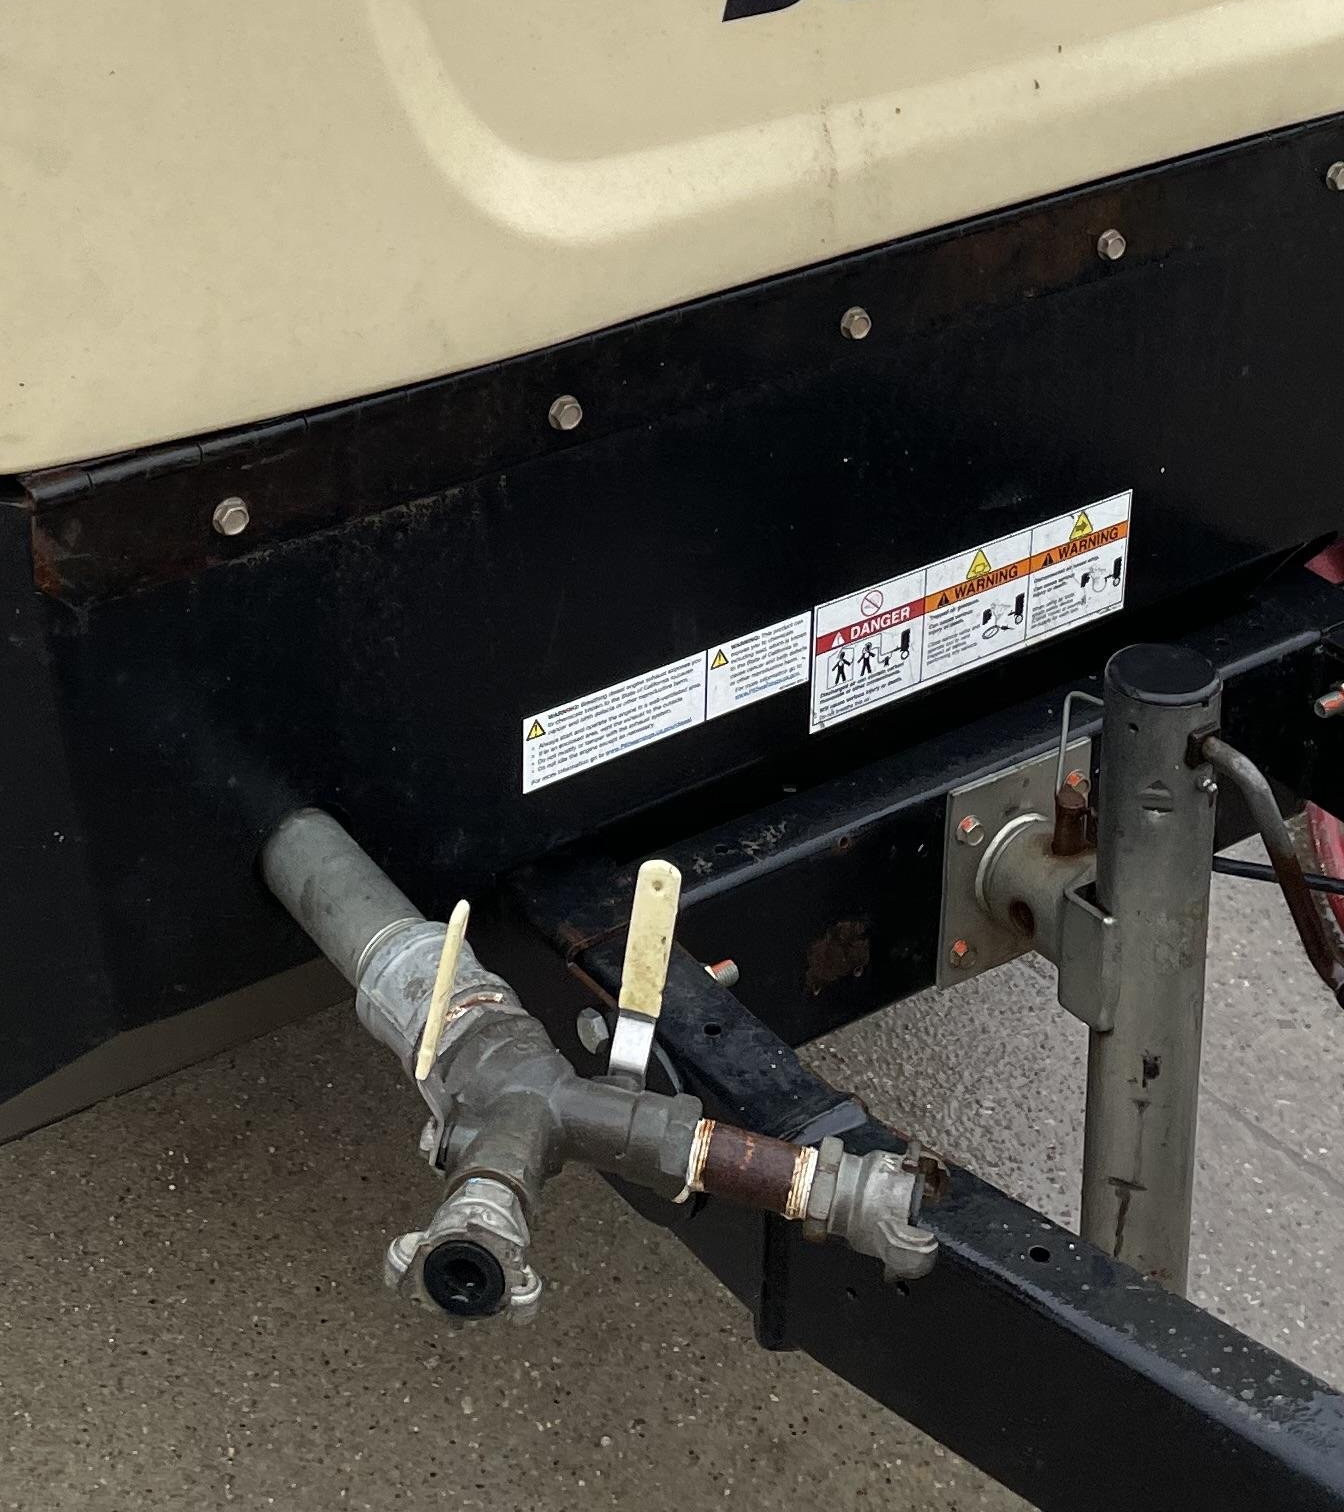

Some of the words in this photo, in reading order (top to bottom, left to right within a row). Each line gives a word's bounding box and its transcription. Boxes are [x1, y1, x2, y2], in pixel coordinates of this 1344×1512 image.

[1058, 527, 1119, 560] WARNING
[954, 565, 1018, 600] WARNING
[850, 606, 911, 640] DANGER
